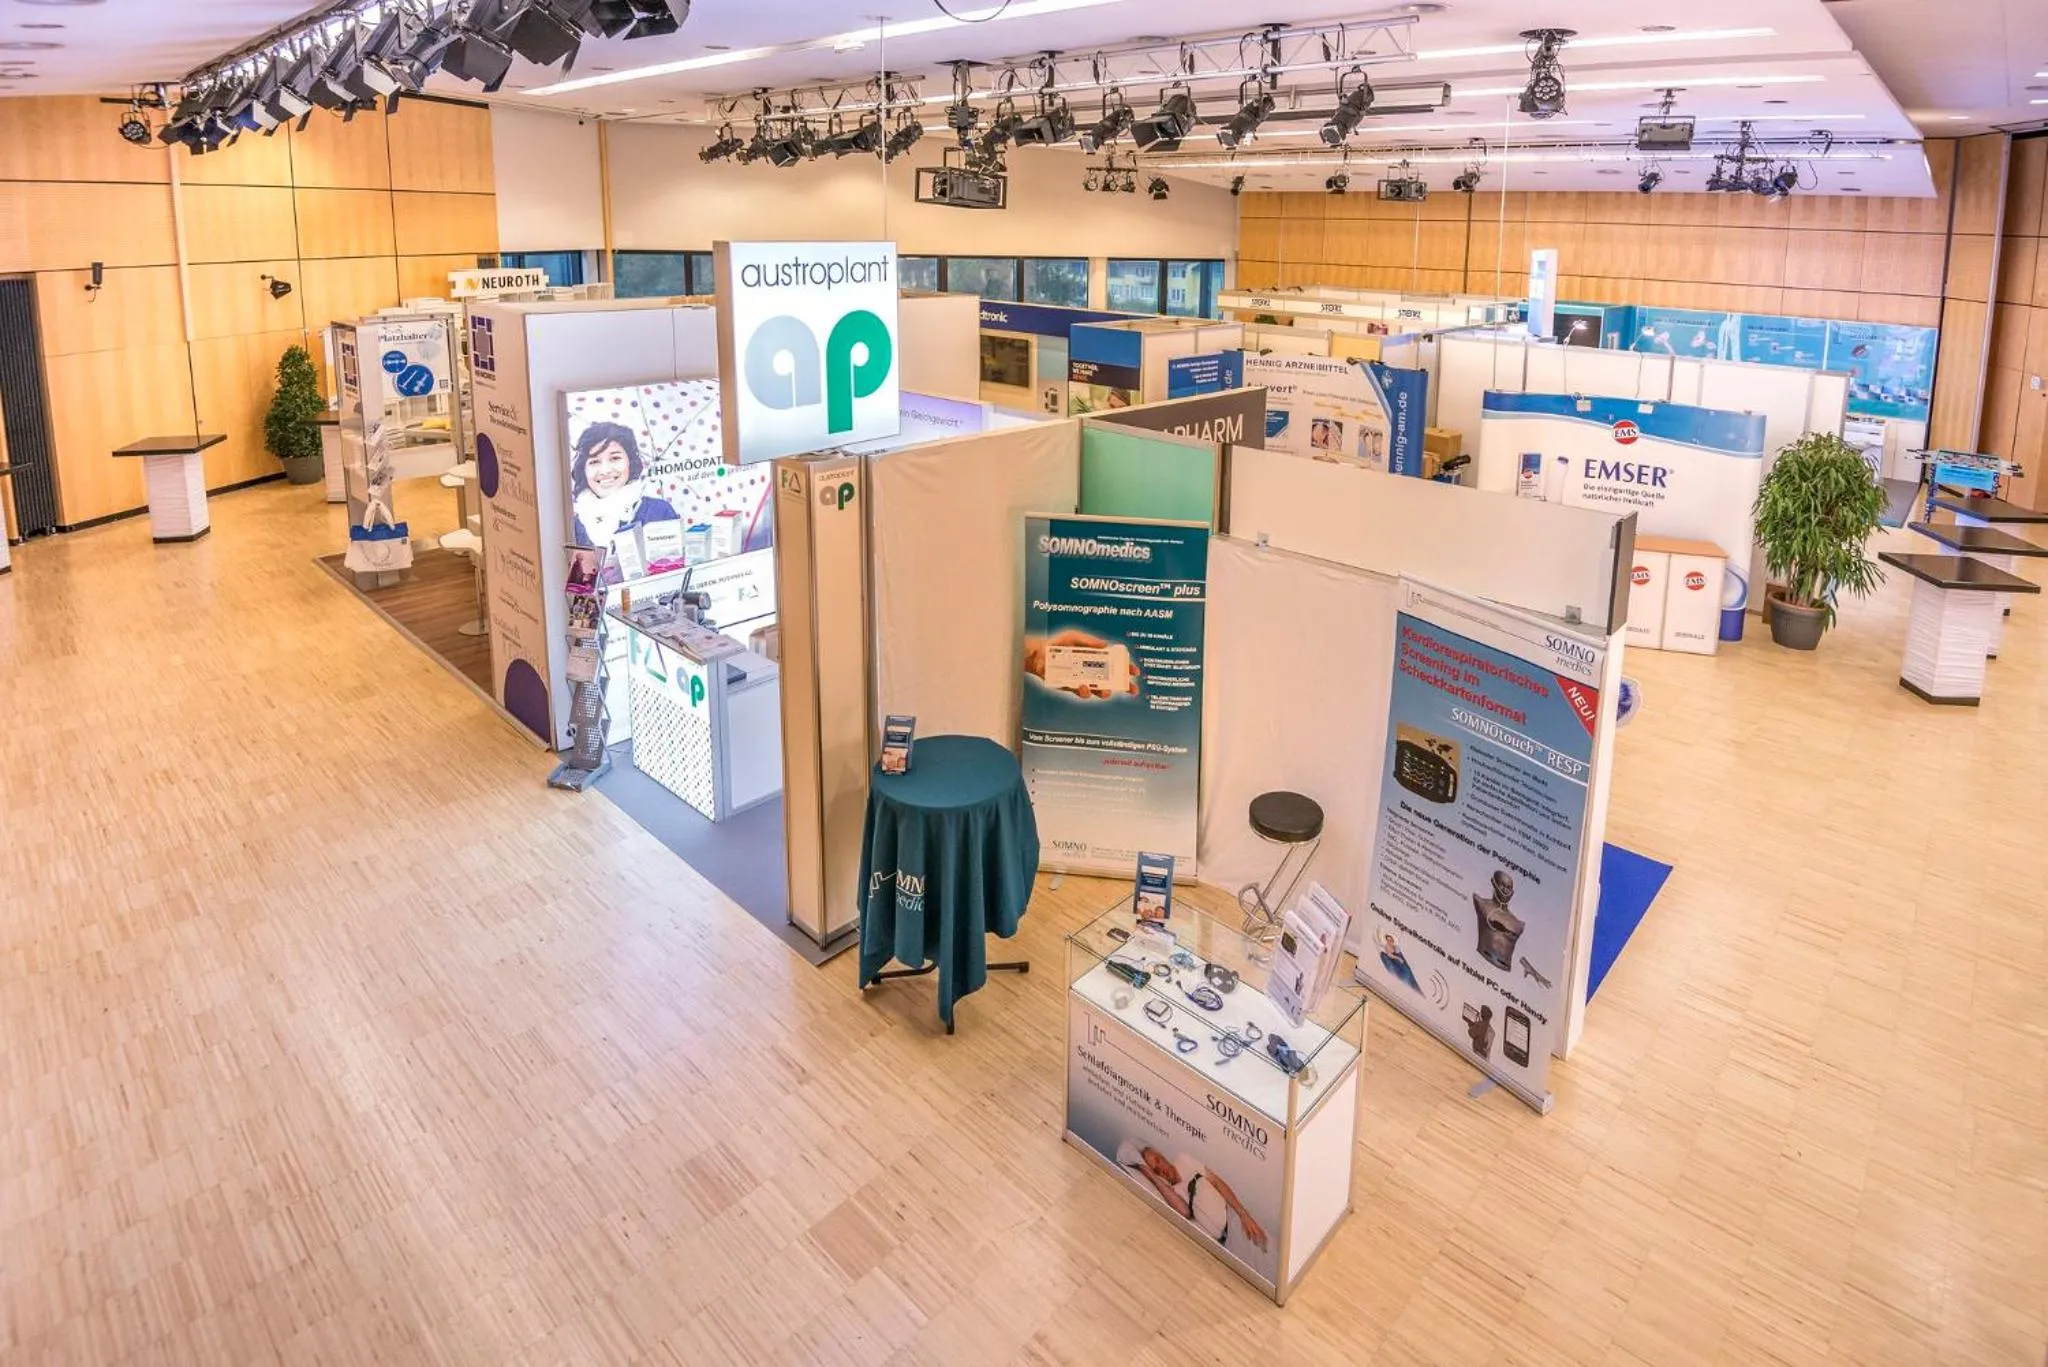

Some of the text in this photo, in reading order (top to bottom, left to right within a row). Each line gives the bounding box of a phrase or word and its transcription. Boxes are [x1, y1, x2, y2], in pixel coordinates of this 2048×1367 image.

[482, 274, 541, 289] NEUROTH
[741, 255, 889, 290] austroplant
[1246, 358, 1282, 368] HENNIG
[1285, 360, 1349, 375] ARZNEIMITTEL
[1163, 414, 1244, 443] PHARM
[1614, 427, 1637, 438] EMS
[1584, 483, 1666, 501] Die einzigartige Quelle
[1623, 496, 1655, 508] Heilkraft
[1039, 535, 1152, 561] SOMNOmedics
[1174, 583, 1201, 597] plus
[1033, 600, 1174, 619] Polysomnographie nach AASM
[1402, 625, 1549, 698] Kardiorespiratorisches
[1545, 634, 1596, 664] SOMNO
[1401, 642, 1481, 686] Screening im
[1555, 656, 1593, 677] medics
[1398, 658, 1528, 725] Scheckkartenformat
[1568, 686, 1597, 721] NEU!
[1028, 732, 1044, 741] Vom
[1044, 733, 1075, 745] Screener
[1075, 735, 1086, 745] bis
[1086, 738, 1100, 746] zum
[1101, 738, 1146, 750] vollständigen
[1546, 751, 1583, 775] RESP
[1052, 840, 1088, 852] SOMNO
[1400, 801, 1412, 813] Die
[1413, 809, 1432, 823] neue
[1433, 819, 1476, 847] Generation
[1477, 843, 1491, 856] der
[1492, 849, 1541, 885] Polygraphie
[896, 894, 924, 912] edic
[1370, 902, 1548, 1025] Online Signalkontrolle auf Tablet PC oder Handy
[1077, 1044, 1152, 1102] Schlafdiagnostik
[1154, 1097, 1163, 1110] &
[1163, 1102, 1208, 1143] Therapie
[1206, 1093, 1268, 1145] SOMNO
[1222, 1125, 1266, 1162] medics
